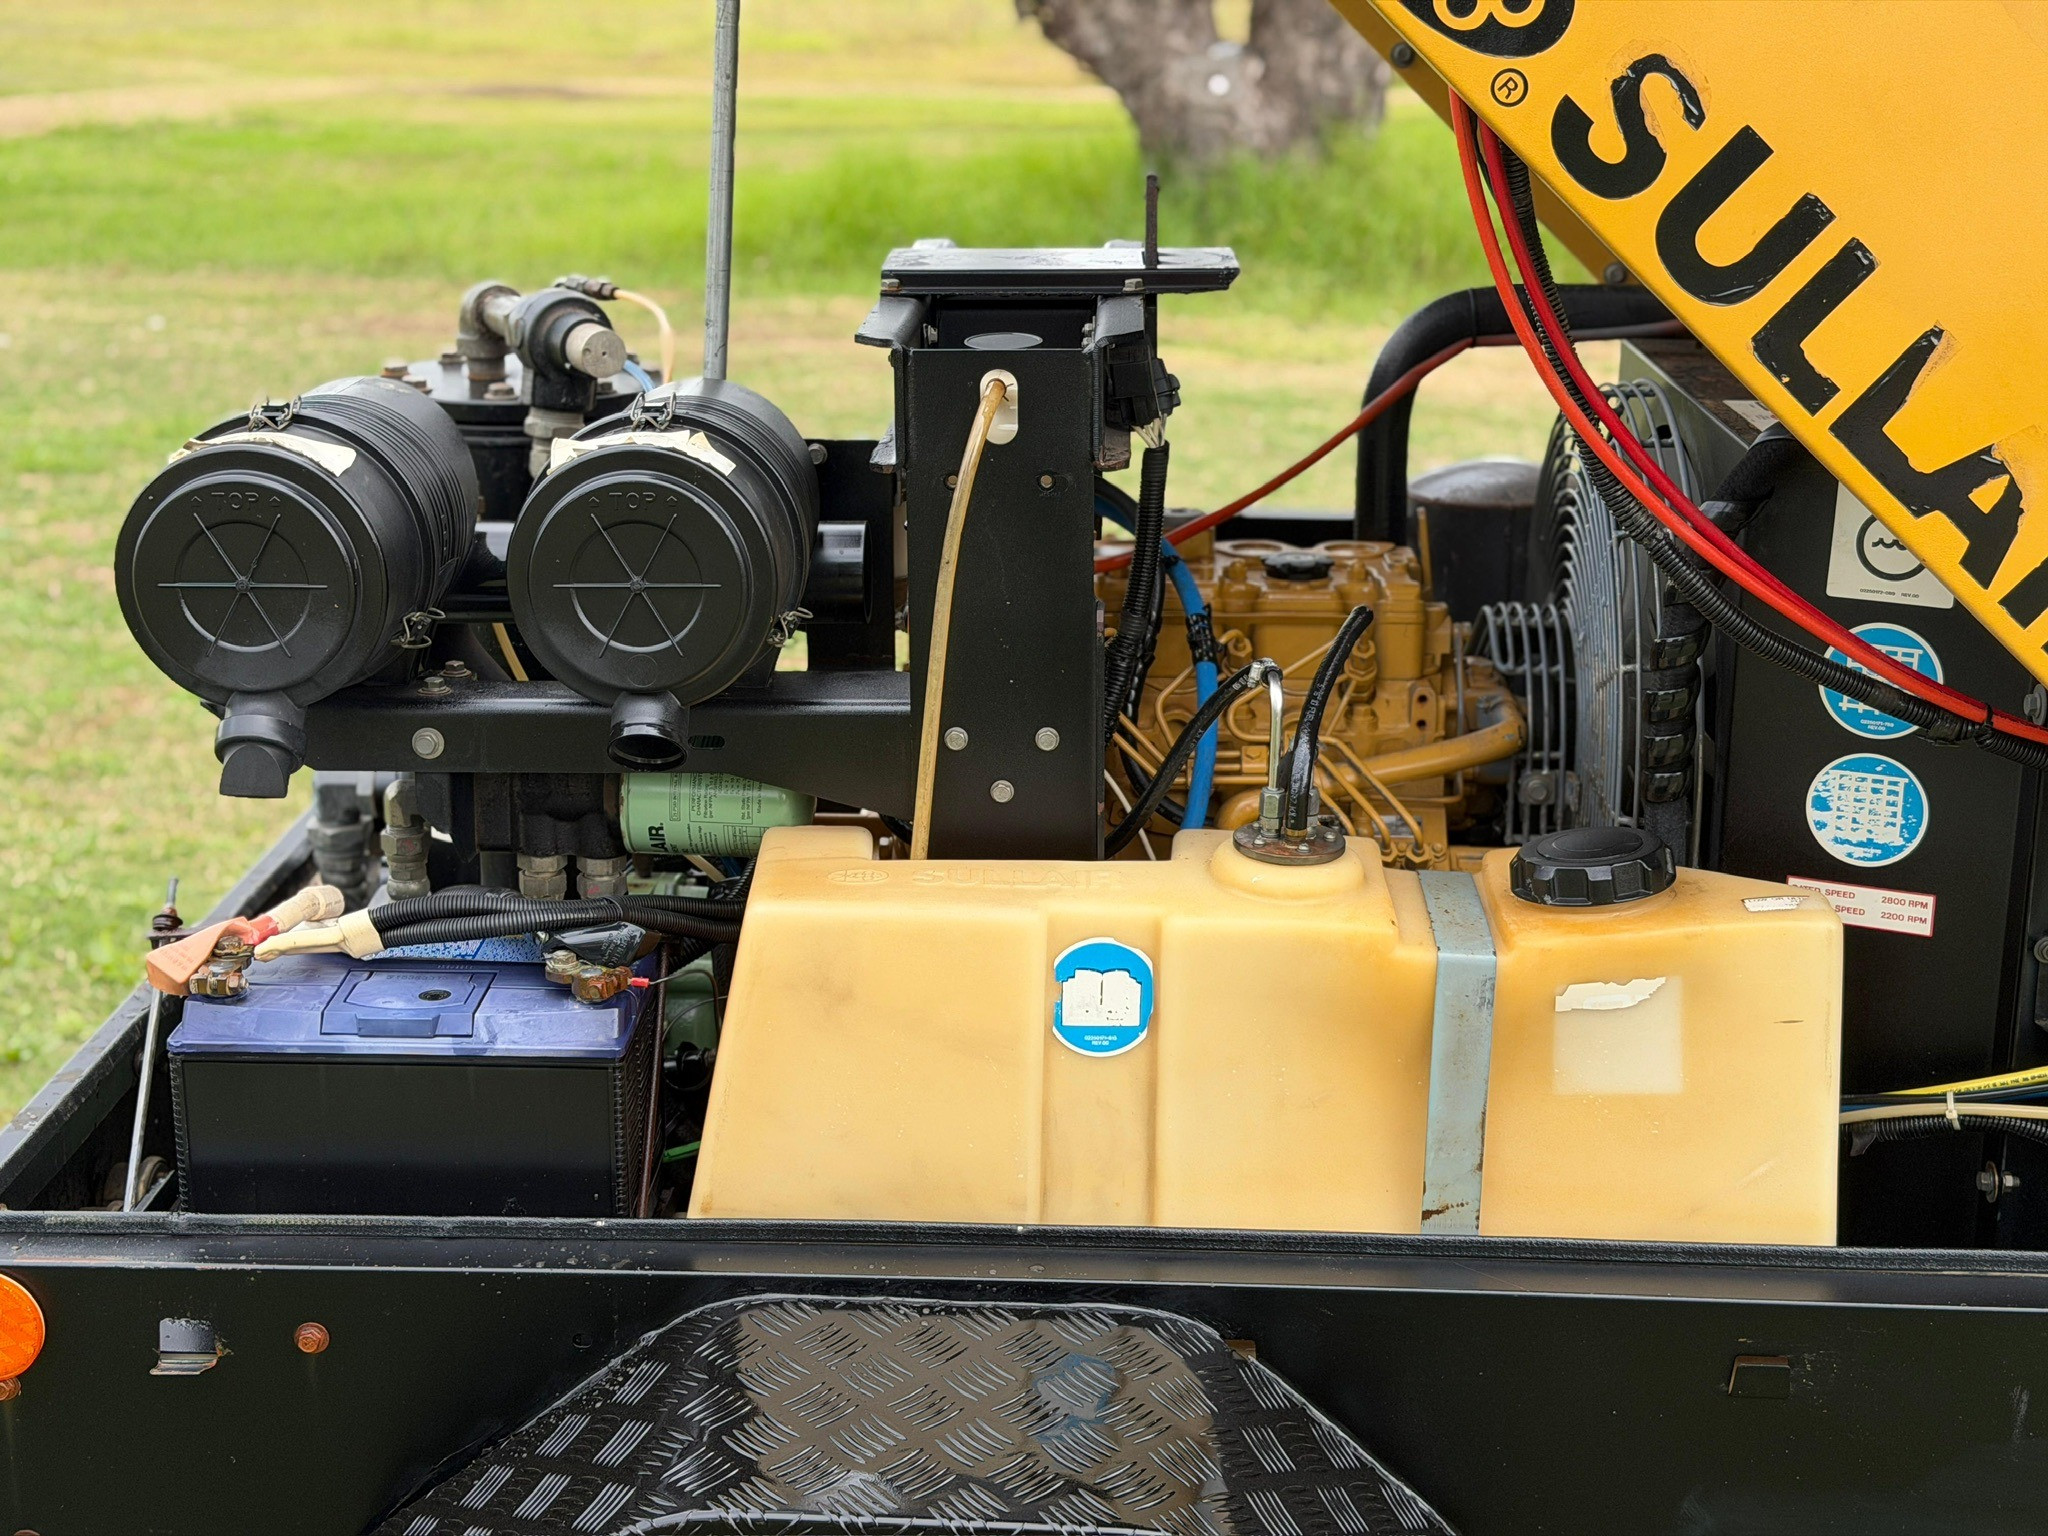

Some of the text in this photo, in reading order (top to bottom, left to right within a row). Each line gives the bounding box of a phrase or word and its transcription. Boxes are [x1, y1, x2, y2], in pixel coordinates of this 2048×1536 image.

[1551, 53, 2048, 656] SULLA
[211, 491, 260, 510] TOP
[608, 491, 656, 511] TOP
[1824, 888, 1856, 900] SPEED
[1881, 895, 1906, 907] 2800
[1908, 899, 1929, 910] RPM
[1834, 904, 1928, 925] SPEED 2200 RPM
